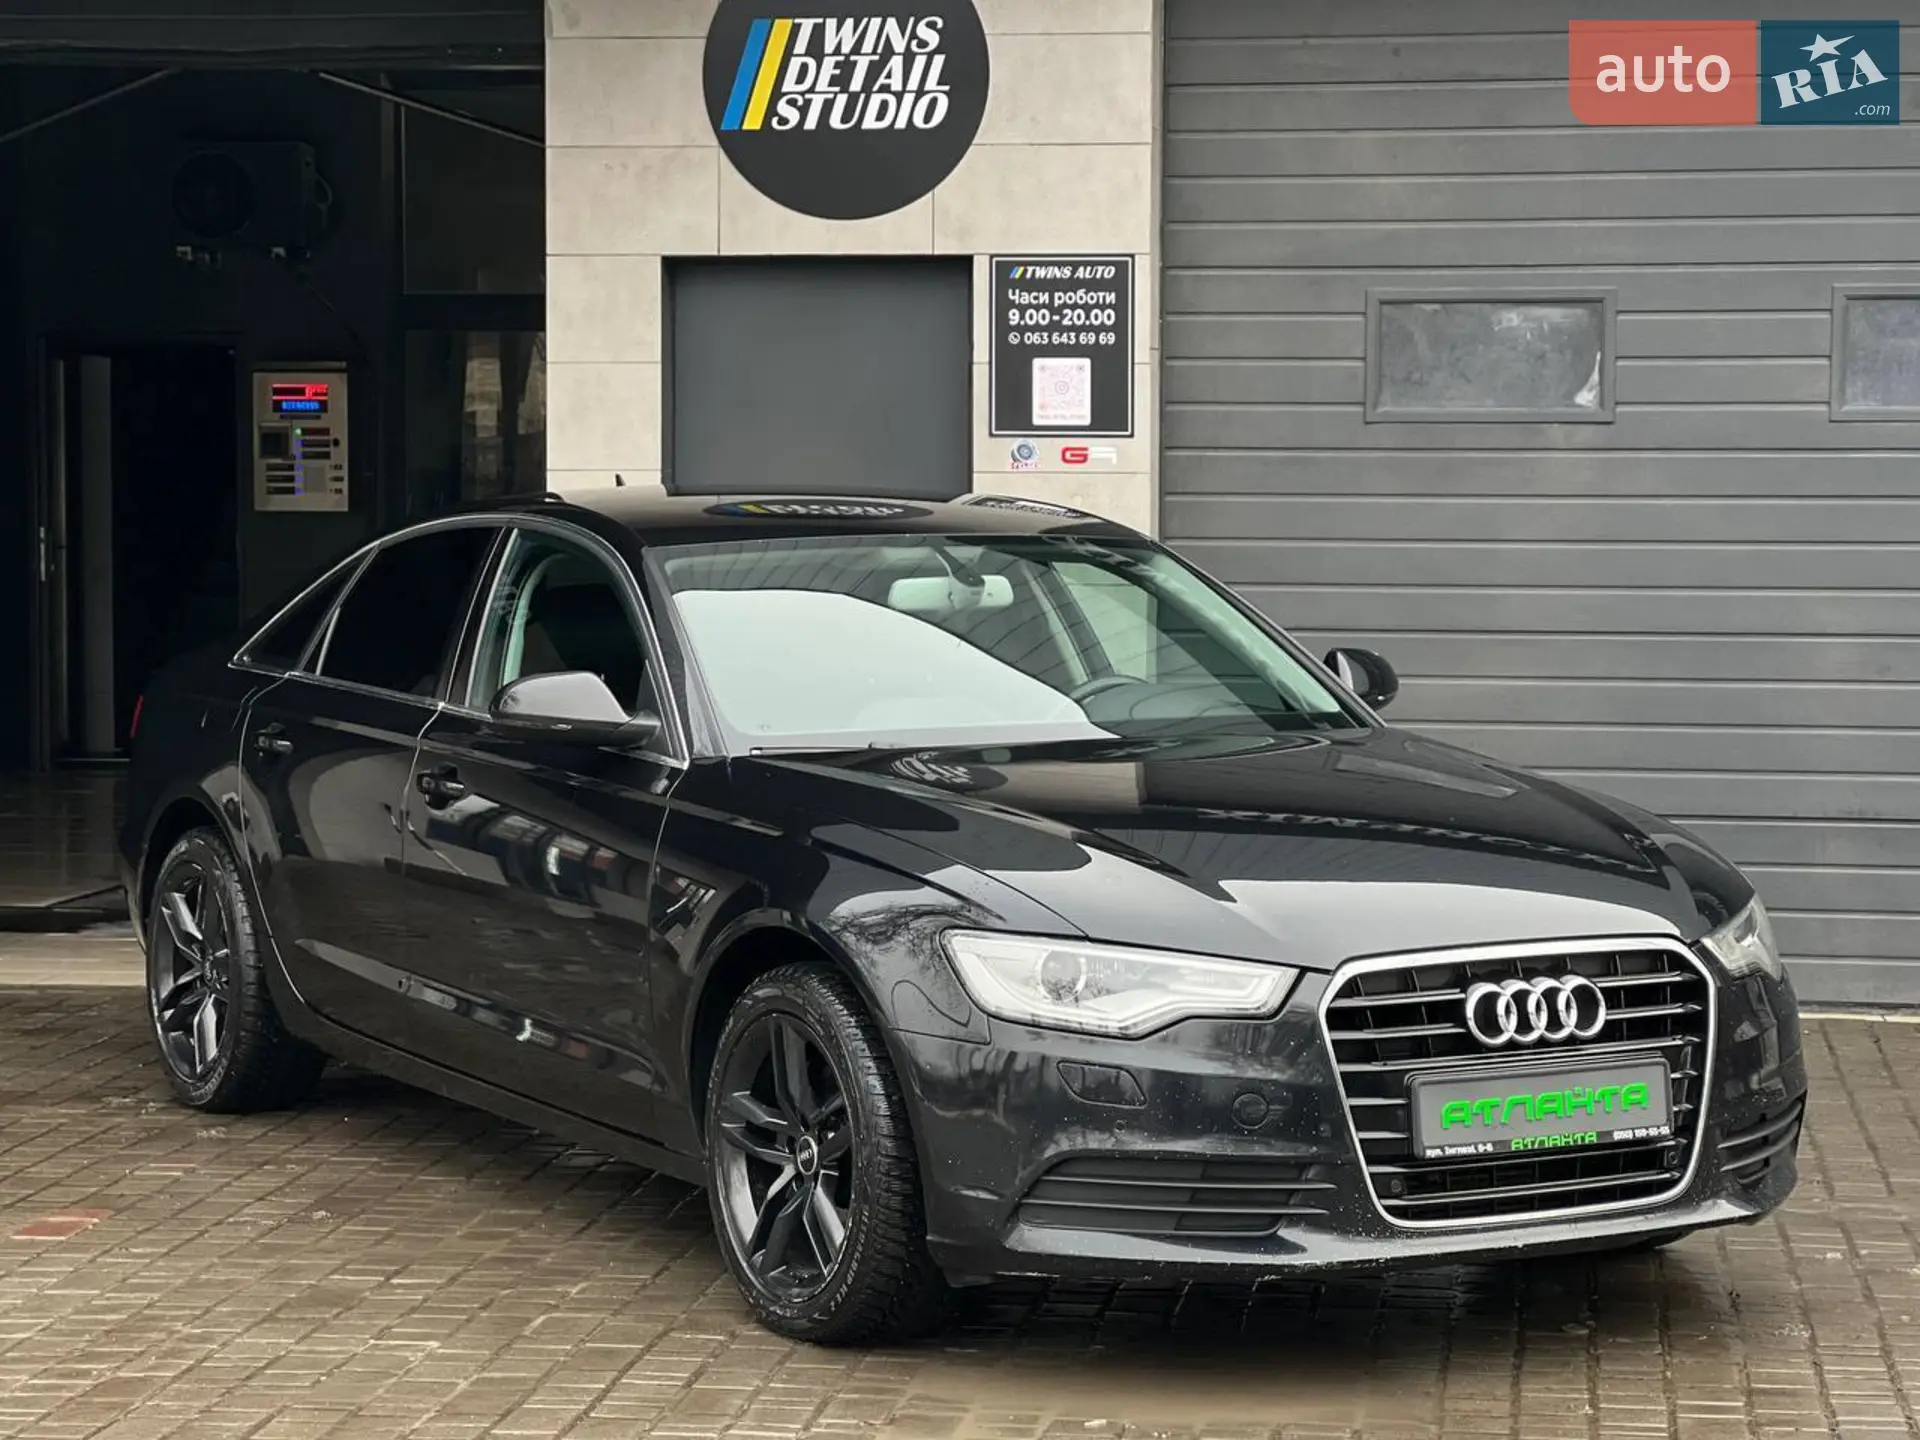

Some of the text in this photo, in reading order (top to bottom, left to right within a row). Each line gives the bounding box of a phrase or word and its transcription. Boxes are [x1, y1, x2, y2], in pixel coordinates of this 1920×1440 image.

[793, 16, 944, 54] TWINS
[781, 54, 950, 93] DETAIL
[771, 92, 950, 130] STUDIO
[1025, 265, 1116, 279] TWINS AUTO
[1008, 288, 1116, 307] Часи роботи
[1024, 332, 1116, 345] 063 643 69 69
